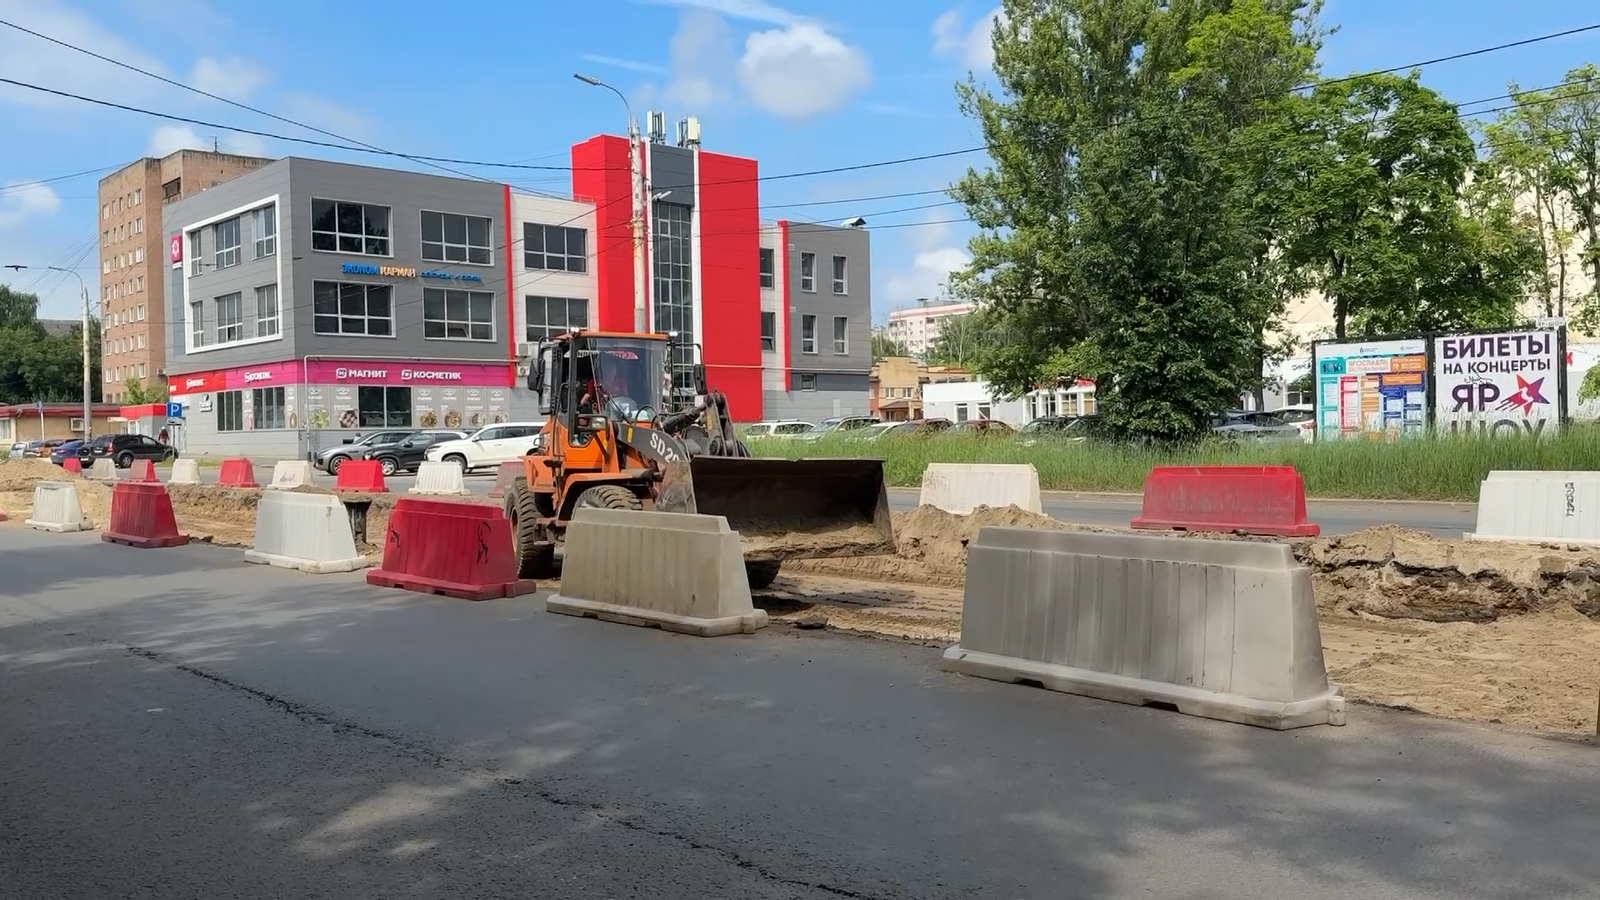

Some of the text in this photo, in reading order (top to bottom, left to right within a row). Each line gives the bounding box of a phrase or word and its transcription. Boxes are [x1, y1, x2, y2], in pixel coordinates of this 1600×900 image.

[380, 266, 416, 278] КАРМАН
[1443, 333, 1550, 360] БИЛЕТЫ
[348, 369, 388, 379] МАГНИТ
[1443, 359, 1551, 375] НА КОНЦЕРТЫ
[413, 371, 462, 380] КОСМЕТИК
[1451, 383, 1501, 412] ЯР
